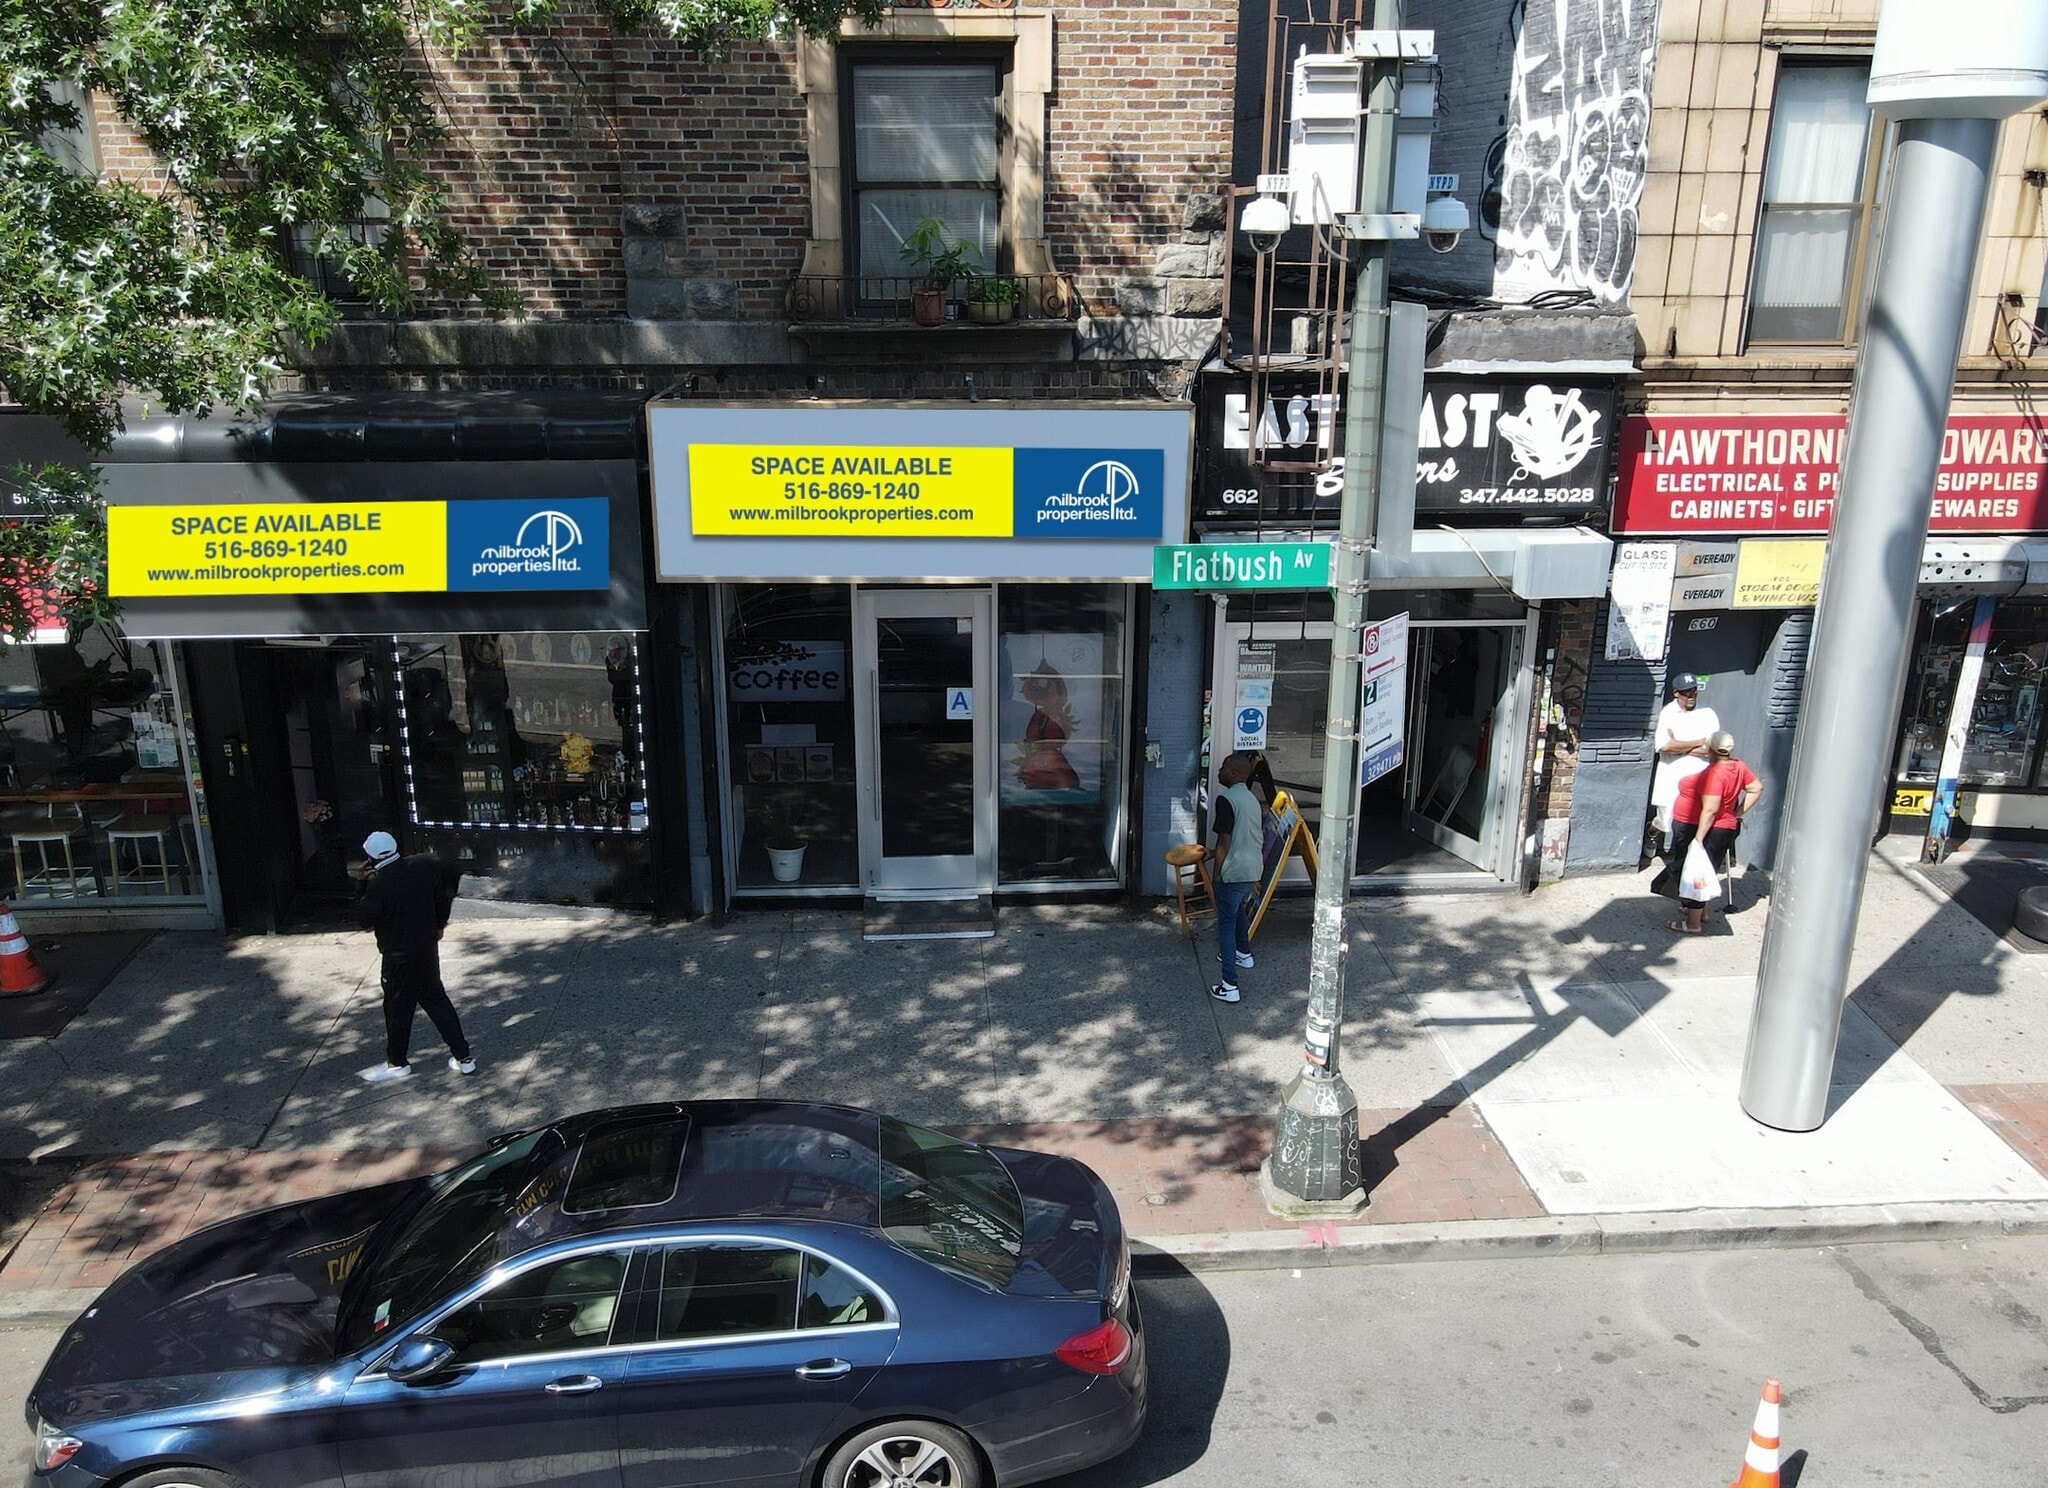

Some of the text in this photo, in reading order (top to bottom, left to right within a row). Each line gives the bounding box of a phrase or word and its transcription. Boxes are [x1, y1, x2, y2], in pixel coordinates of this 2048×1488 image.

[1428, 175, 1454, 190] NYPD
[1418, 391, 1499, 448] AST
[751, 456, 952, 476] SPACE AVAILABLE
[784, 482, 920, 500] 516-869-1240
[1656, 473, 1784, 492] ELECTRICAL
[1793, 472, 1807, 491] &
[1936, 472, 2039, 492] SUPPLIES
[1045, 493, 1109, 507] milbrook
[1222, 488, 1259, 504] 662
[1459, 487, 1595, 504] 347.442.5028
[729, 505, 974, 524] www.milbrookproperties.com
[1037, 507, 1109, 523] properties
[1669, 499, 1774, 519] CABINETS
[1930, 498, 2019, 518] EWARES
[171, 512, 382, 536] SPACE AVAILABLE
[204, 538, 348, 559] 516-869-1240
[481, 545, 550, 559] milbrook
[1623, 550, 1668, 560] GLASS
[472, 557, 551, 576] properties
[1172, 548, 1314, 583] Flatbush Av
[1693, 553, 1736, 565] EVEREADY
[147, 562, 405, 581] www.milbrookproperties.com
[1682, 588, 1726, 600] EVEREADY
[1690, 619, 1716, 630] 660
[1239, 663, 1272, 673] WANTED
[733, 669, 840, 691] coffee
[951, 691, 969, 711] A
[1366, 683, 1375, 705] 2
